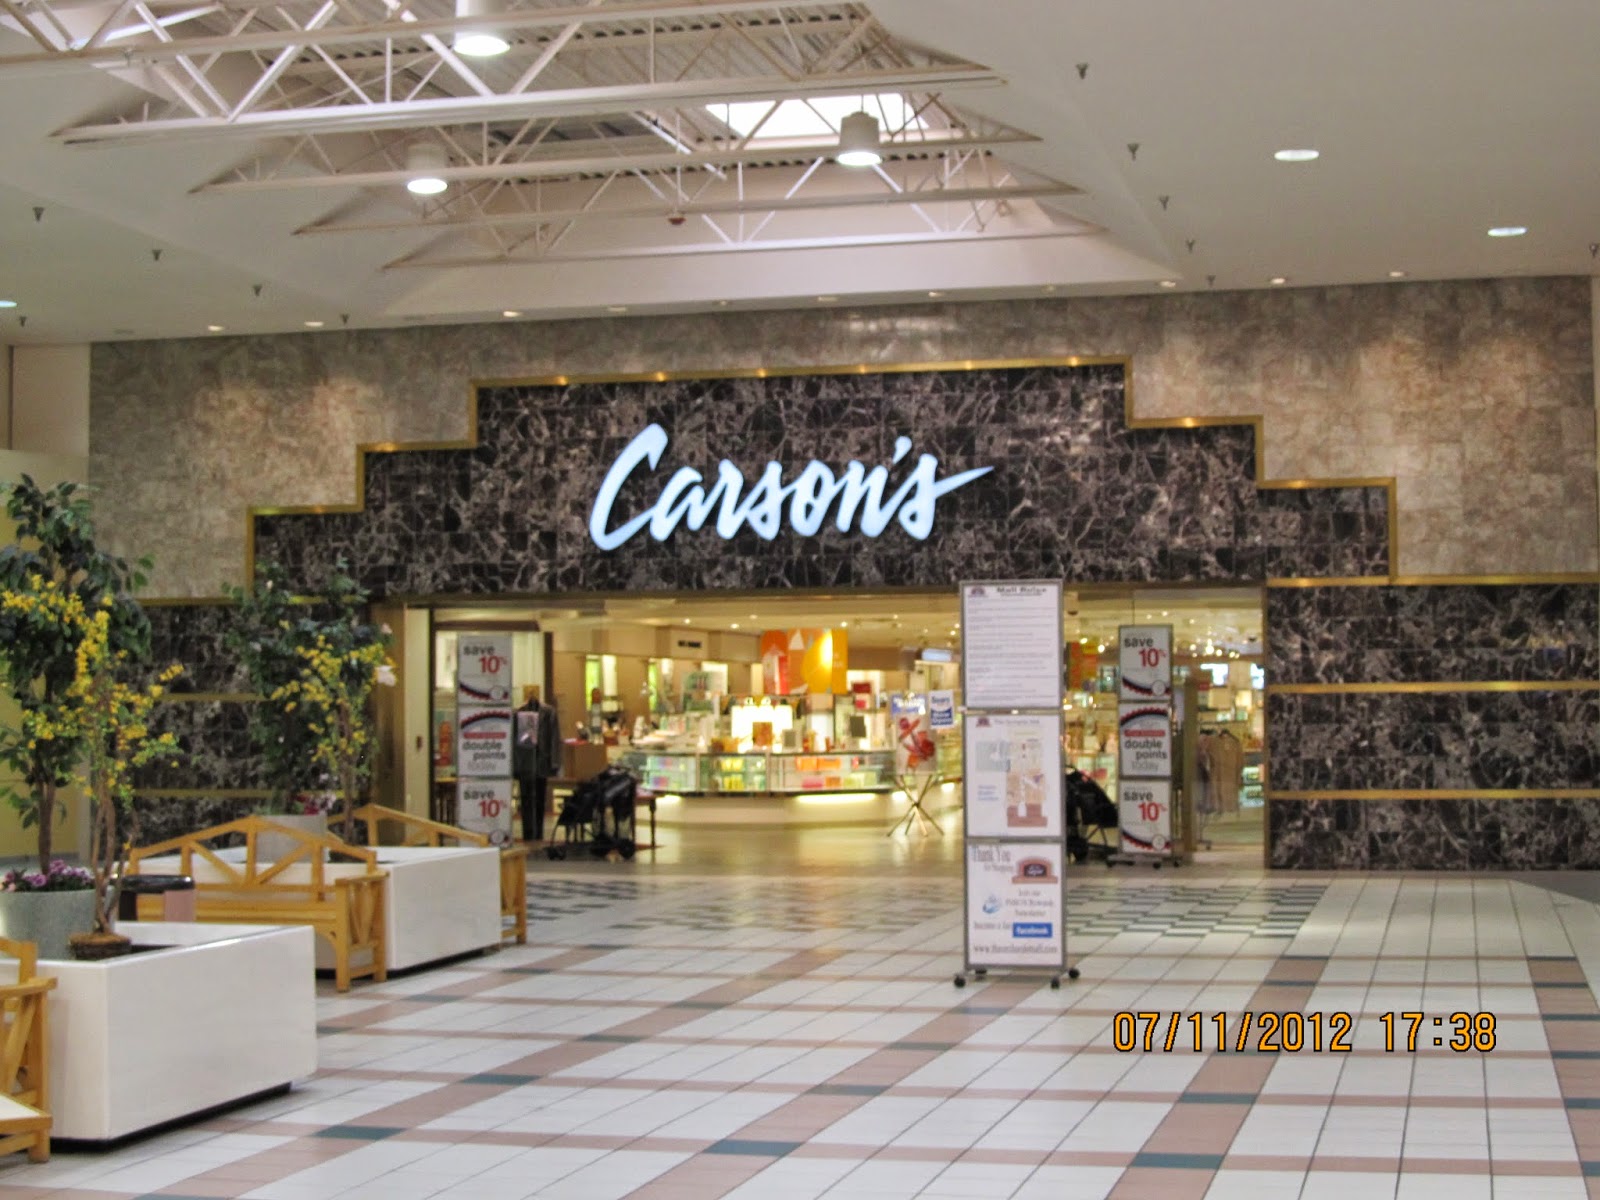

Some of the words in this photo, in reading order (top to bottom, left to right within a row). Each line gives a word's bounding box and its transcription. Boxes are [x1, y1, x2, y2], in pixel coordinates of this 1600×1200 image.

[589, 423, 994, 551] Carson's
[1124, 638, 1154, 648] save
[463, 645, 495, 656] save
[462, 741, 502, 751] double
[1124, 739, 1163, 749] double
[473, 752, 506, 761] points
[1136, 750, 1168, 760] points
[463, 790, 495, 800] save
[1123, 791, 1154, 801] save
